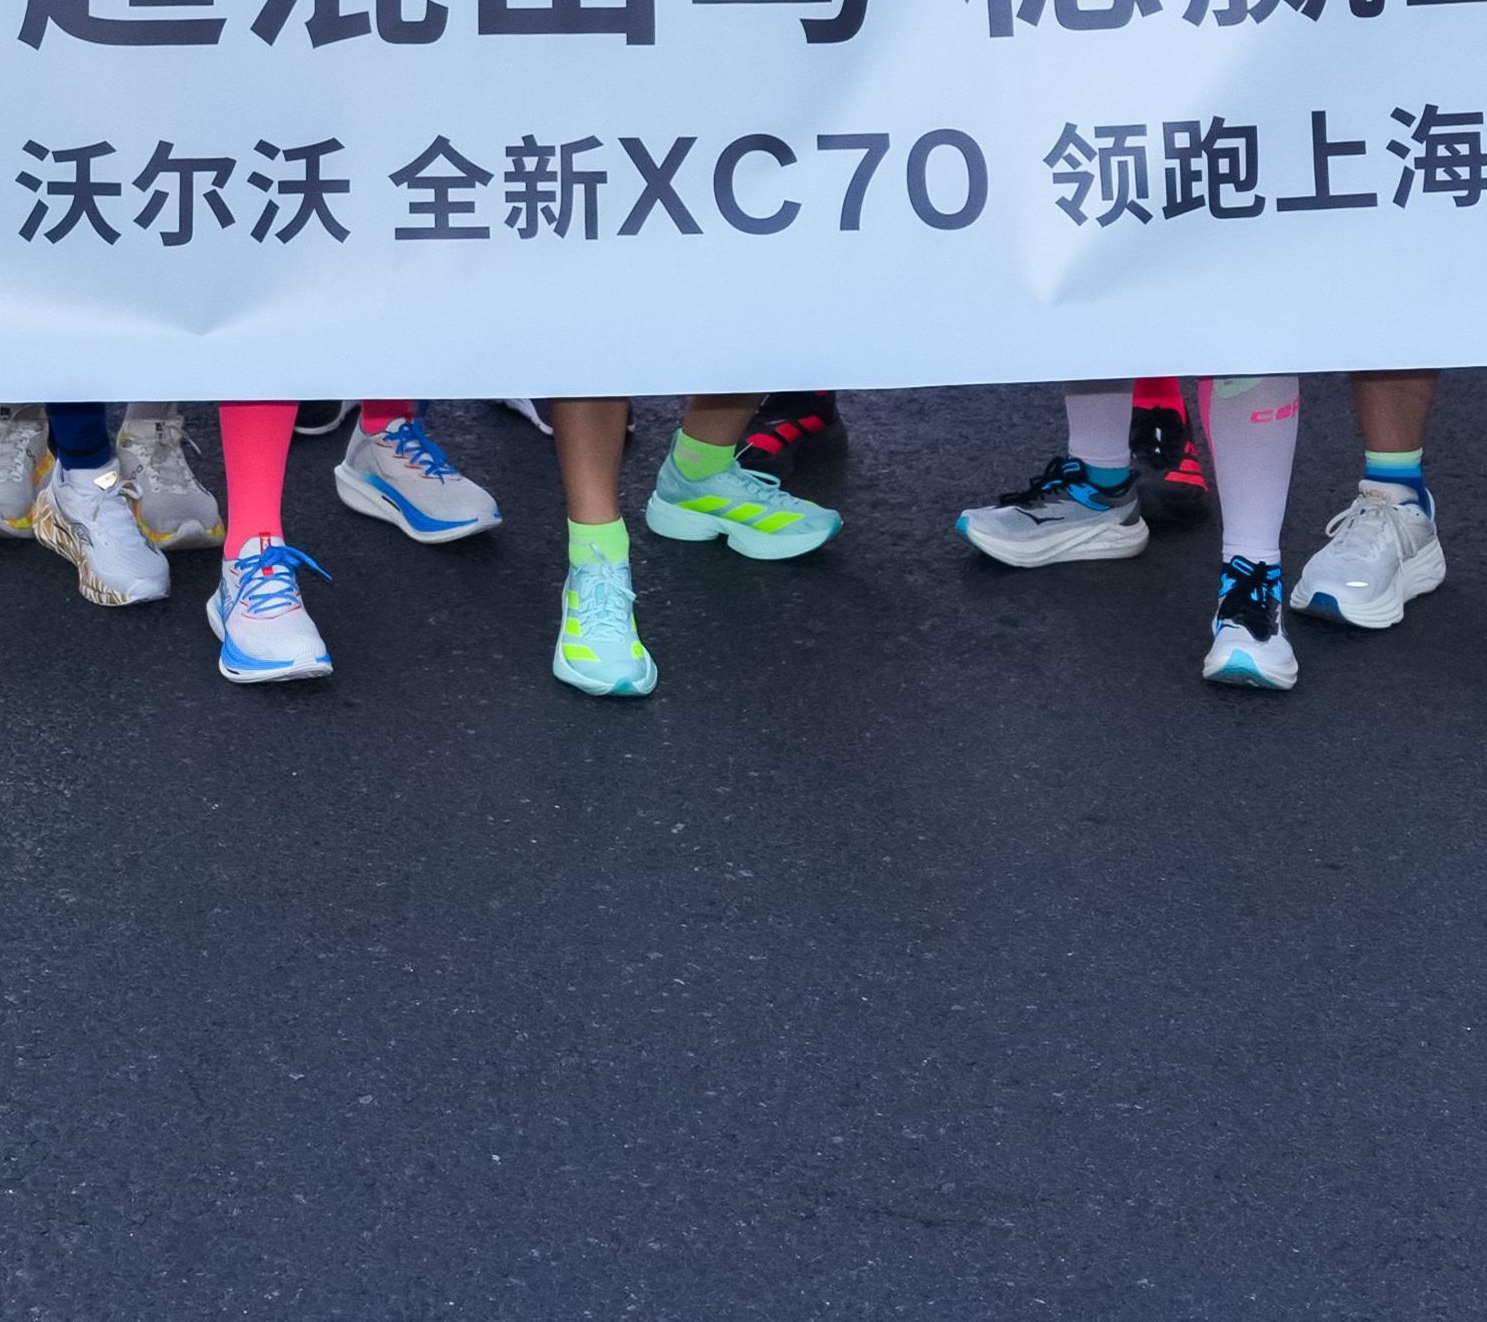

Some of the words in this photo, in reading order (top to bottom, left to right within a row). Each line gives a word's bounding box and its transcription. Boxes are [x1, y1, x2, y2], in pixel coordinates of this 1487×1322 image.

[15, 134, 351, 248] 沃尔沃
[388, 127, 990, 247] 全新XC70
